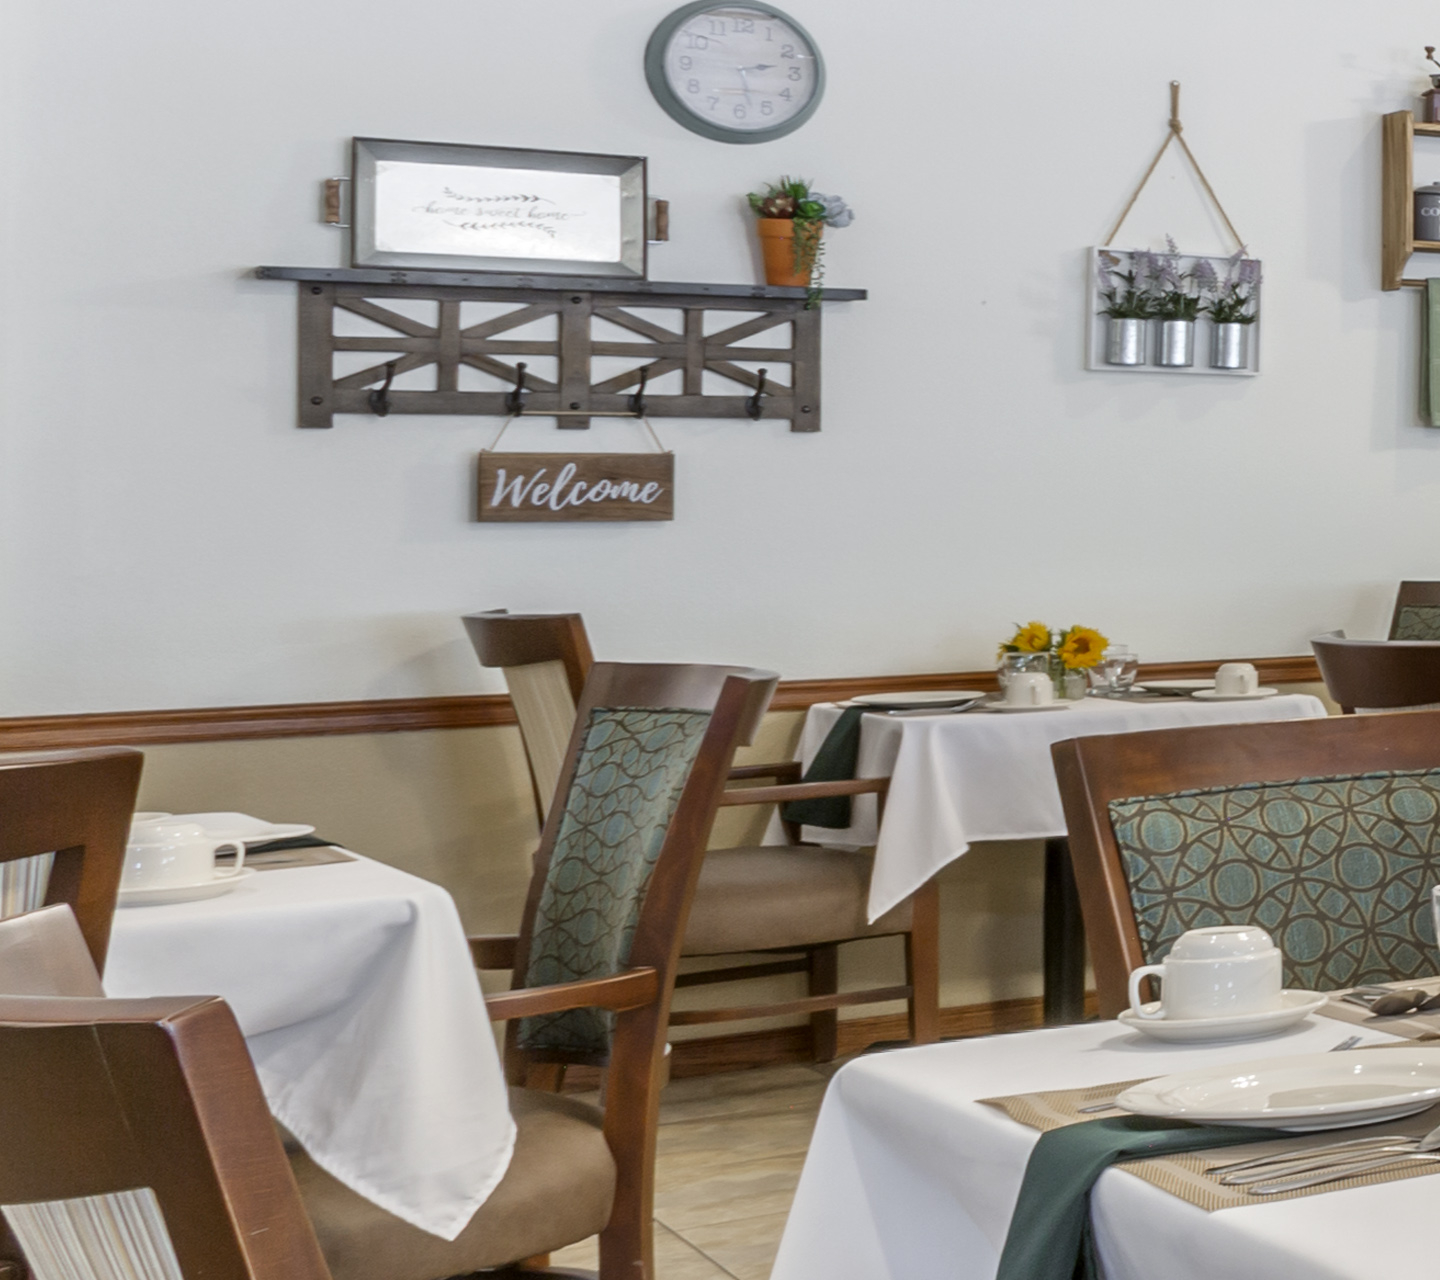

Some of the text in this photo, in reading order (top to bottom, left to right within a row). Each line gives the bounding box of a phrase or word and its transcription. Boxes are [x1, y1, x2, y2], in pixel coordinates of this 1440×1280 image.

[709, 21, 726, 36] 11
[731, 18, 755, 34] 12
[765, 27, 773, 41] 1
[686, 34, 708, 50] 10
[780, 44, 795, 60] 2
[679, 55, 692, 71] 9
[788, 66, 801, 81] 3
[687, 79, 700, 94] 8
[778, 88, 793, 102] 4
[707, 96, 719, 111] 7
[760, 101, 774, 116] 5
[733, 104, 747, 119] 6
[490, 462, 665, 511] Welcome
